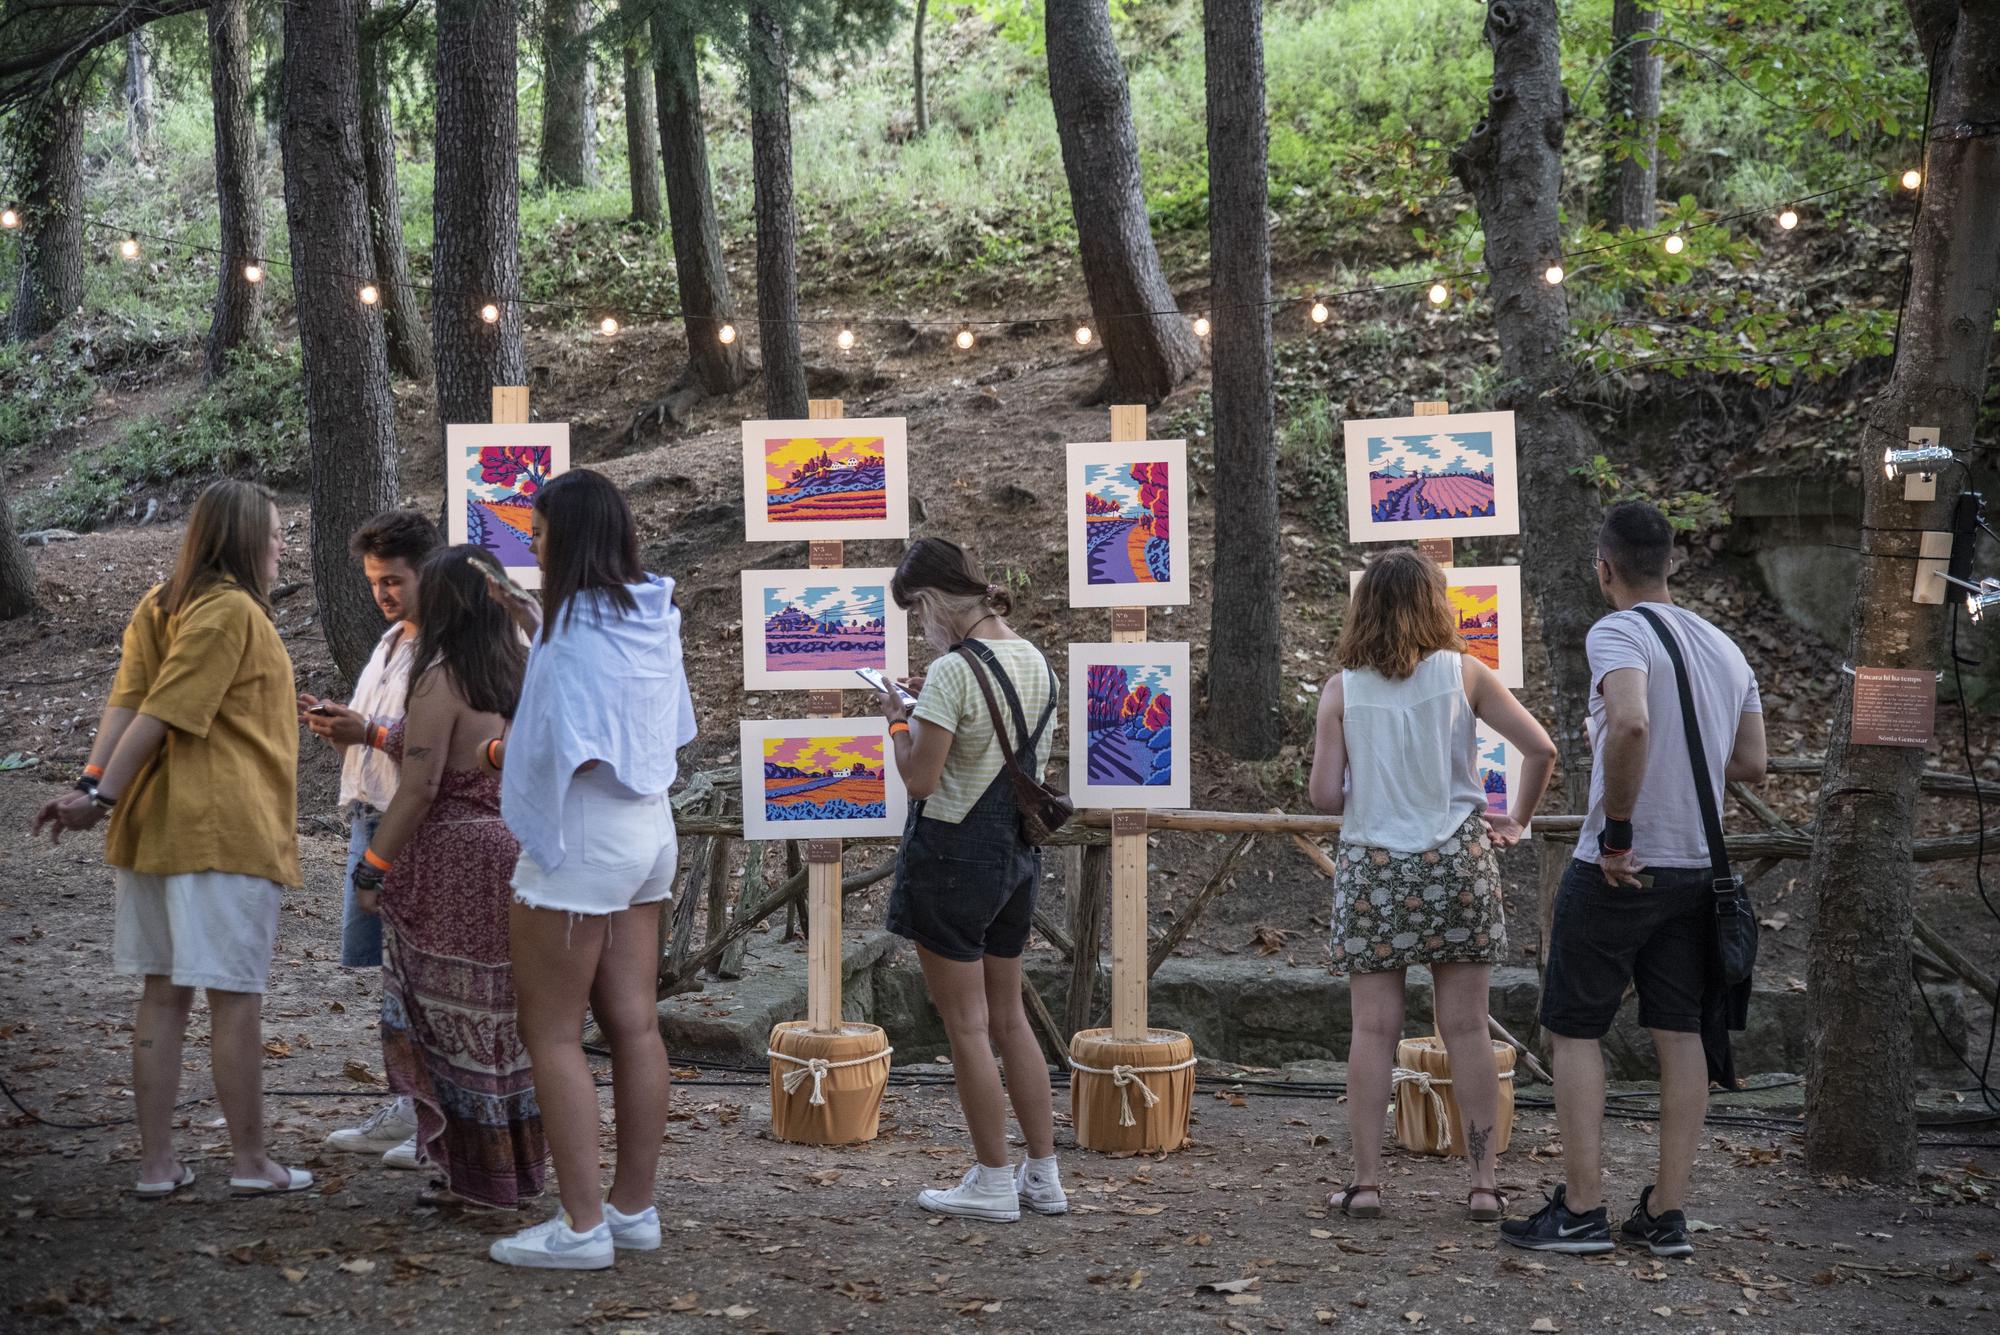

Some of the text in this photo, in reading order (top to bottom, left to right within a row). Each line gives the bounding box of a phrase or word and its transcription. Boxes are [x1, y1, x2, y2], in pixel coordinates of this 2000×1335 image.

[1859, 673, 1882, 681] Encara
[1900, 676, 1922, 684] temps
[1878, 735, 1928, 744] Sónia Genestar
